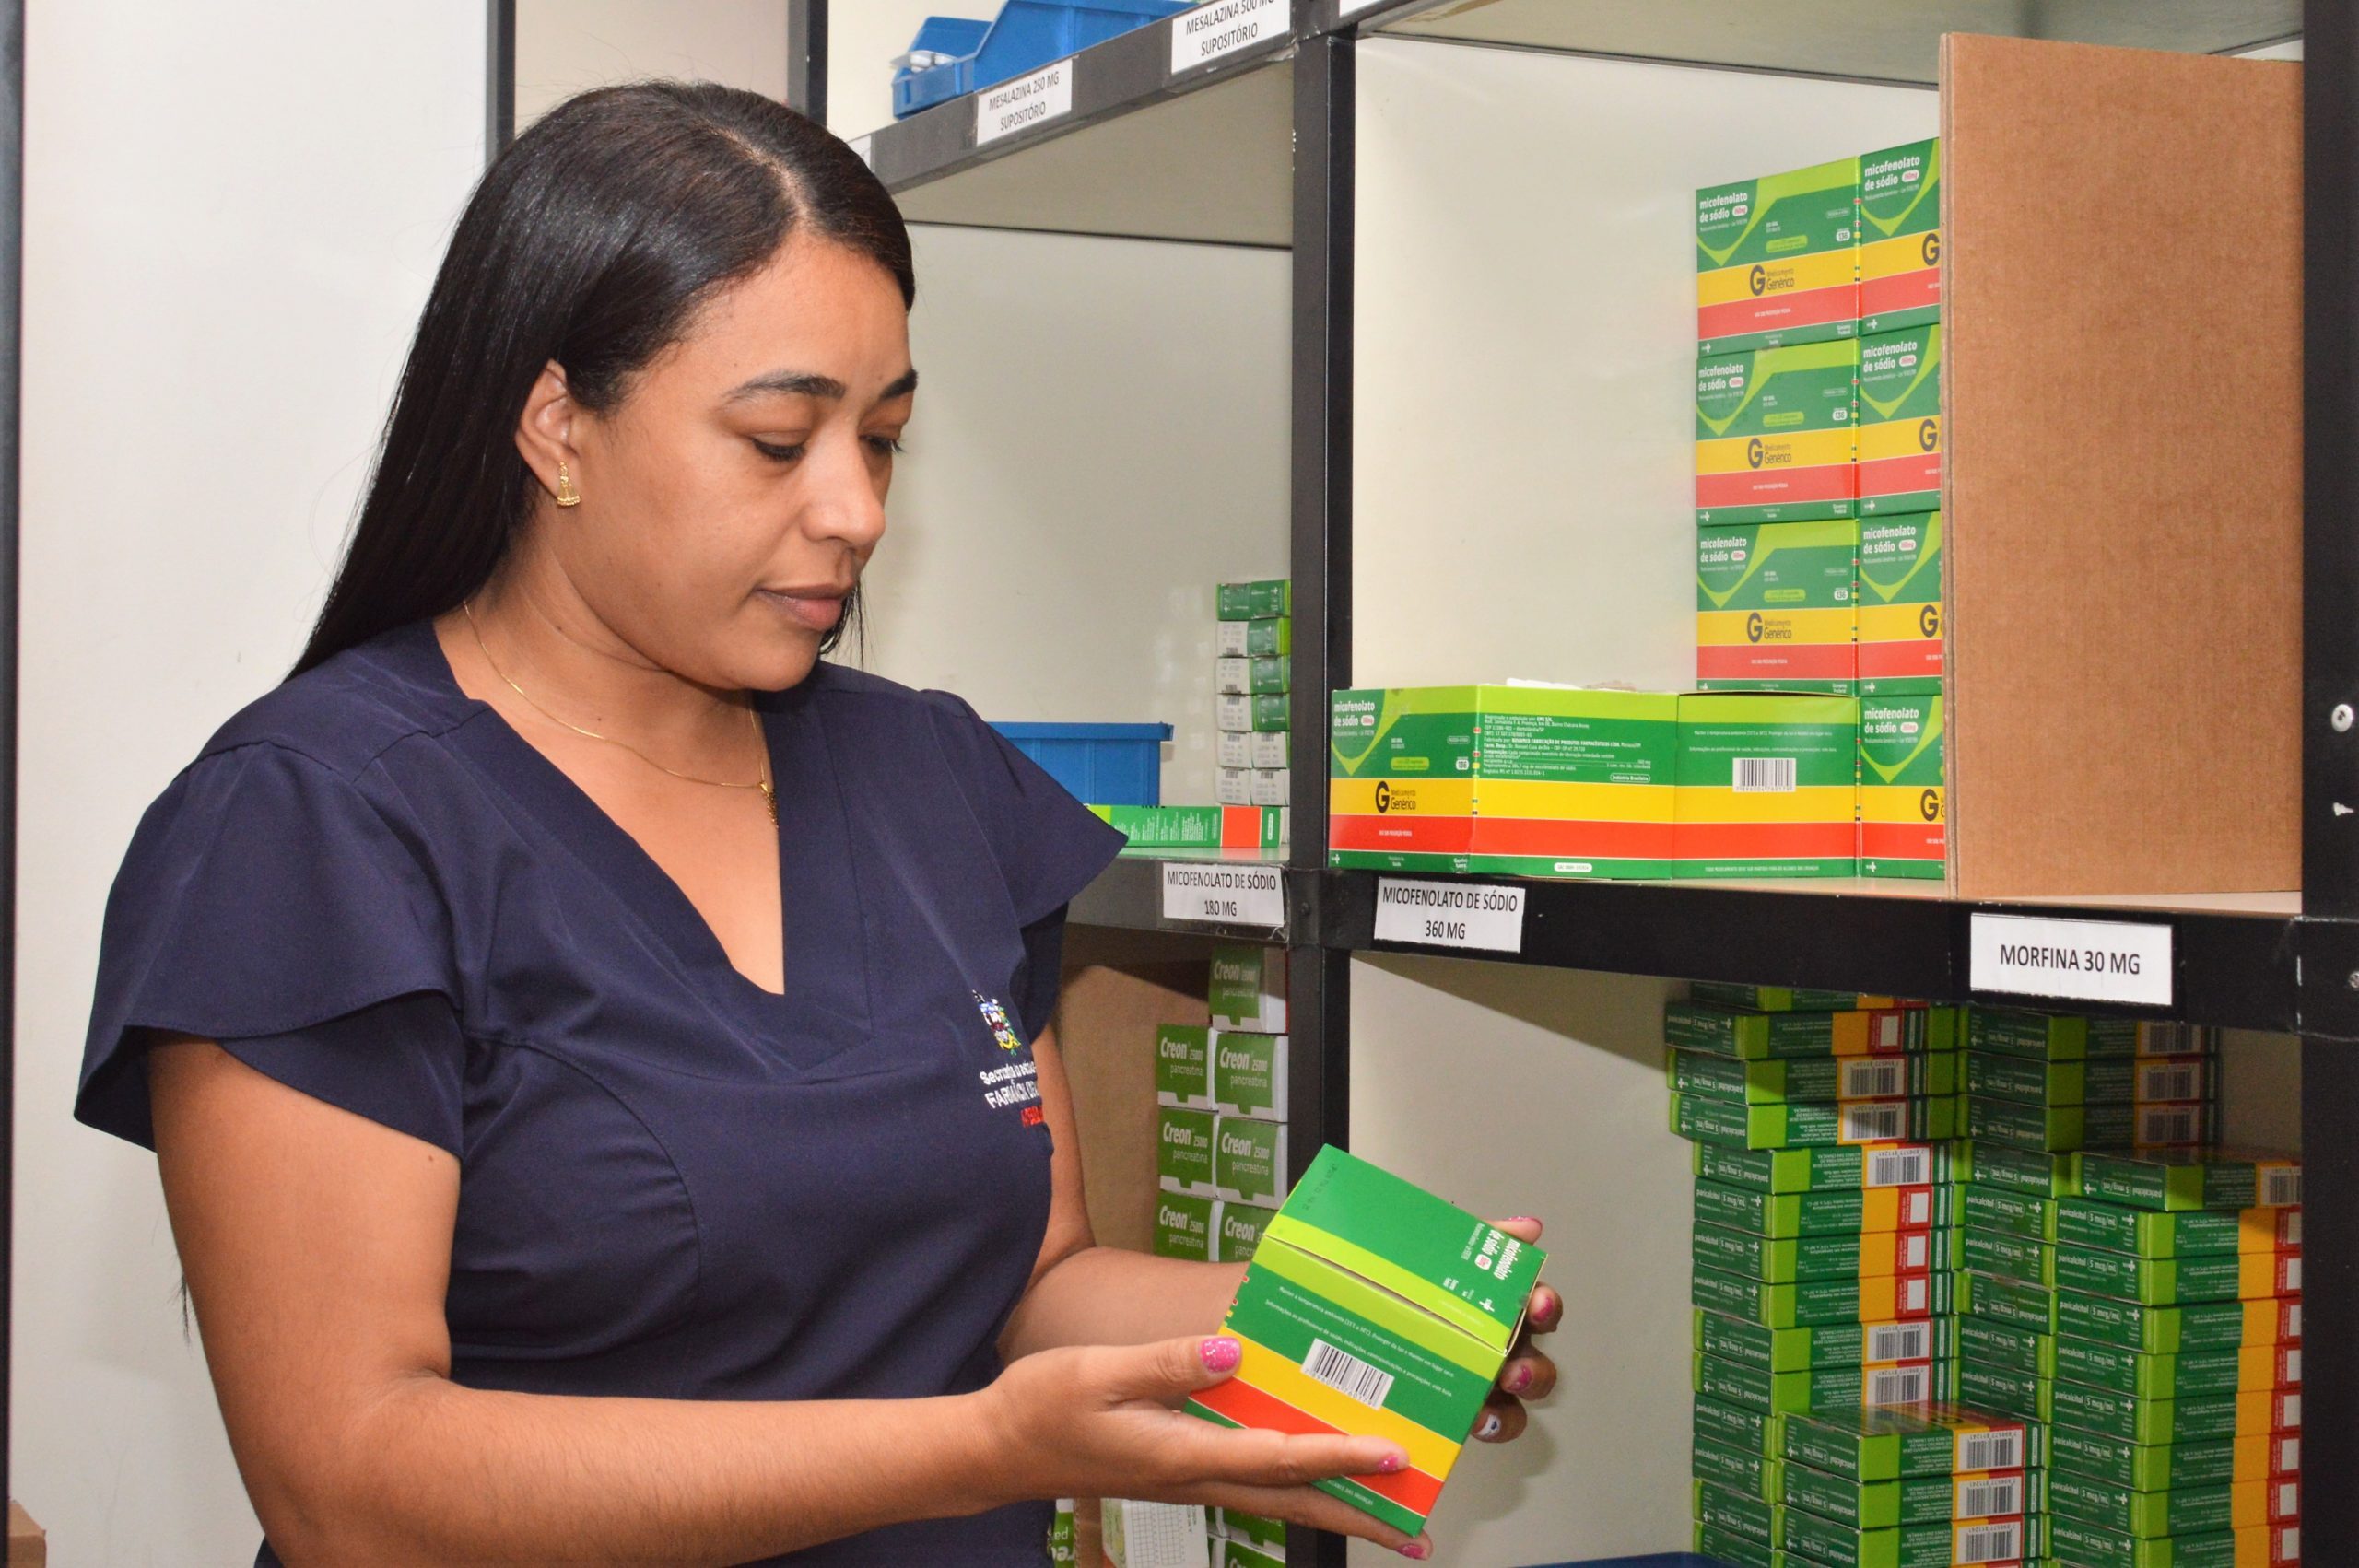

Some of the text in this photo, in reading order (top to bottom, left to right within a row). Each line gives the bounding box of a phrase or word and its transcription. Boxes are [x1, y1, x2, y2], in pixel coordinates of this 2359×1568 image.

[1186, 1, 1238, 35] MESALAZINA
[1241, 0, 1257, 15] 500
[1201, 23, 1257, 57] SUPOSITÓRIO
[989, 71, 1059, 111] MESALAZINA 250 MG
[1001, 101, 1045, 131] SUPOSITÓRIO
[1865, 156, 1920, 177] micofenolato
[1864, 173, 1898, 192] de sódio
[1863, 340, 1917, 357] micofenolato
[1863, 356, 1895, 372] de sódio
[1863, 525, 1916, 540] micofenolato
[1700, 537, 1747, 550] micofenolato
[1863, 539, 1895, 554] de sódio
[1700, 550, 1728, 562] de sódio
[1864, 708, 1919, 720] micofenolato
[1864, 721, 1896, 733] de sódio
[1376, 781, 1390, 813] G
[1391, 797, 1415, 810] Genérico
[1168, 870, 1276, 890] MICOFENOLATO DE SÓDIO
[1383, 887, 1517, 912] MICOFENOLATO DE SÓDIO
[1204, 901, 1237, 917] 180 MG
[1426, 920, 1465, 940] 360 MG
[2001, 944, 2140, 975] MORFINA 30 MG
[1214, 960, 1239, 980] Creon
[1161, 1037, 1187, 1059] Creon
[1220, 1047, 1250, 1070] Creon
[1170, 1065, 1203, 1078] pancreatina
[1230, 1075, 1267, 1089] pancreatina
[1163, 1122, 1191, 1145] Creon
[1221, 1132, 1251, 1156] Creon
[1173, 1149, 1208, 1164] pancreatina
[1232, 1161, 1268, 1179] pancreatina
[1966, 1195, 1994, 1209] paricalcitol
[1159, 1205, 1188, 1229] Creon
[2059, 1208, 2086, 1221] paricalcitol
[1225, 1216, 1255, 1242] Creon
[1168, 1234, 1203, 1248] pancreatina
[2058, 1255, 2086, 1266] paricalcitol
[2060, 1301, 2089, 1313] paricalcitol
[2058, 1346, 2085, 1359] paricalcitol
[2055, 1390, 2083, 1404] paricalcitol
